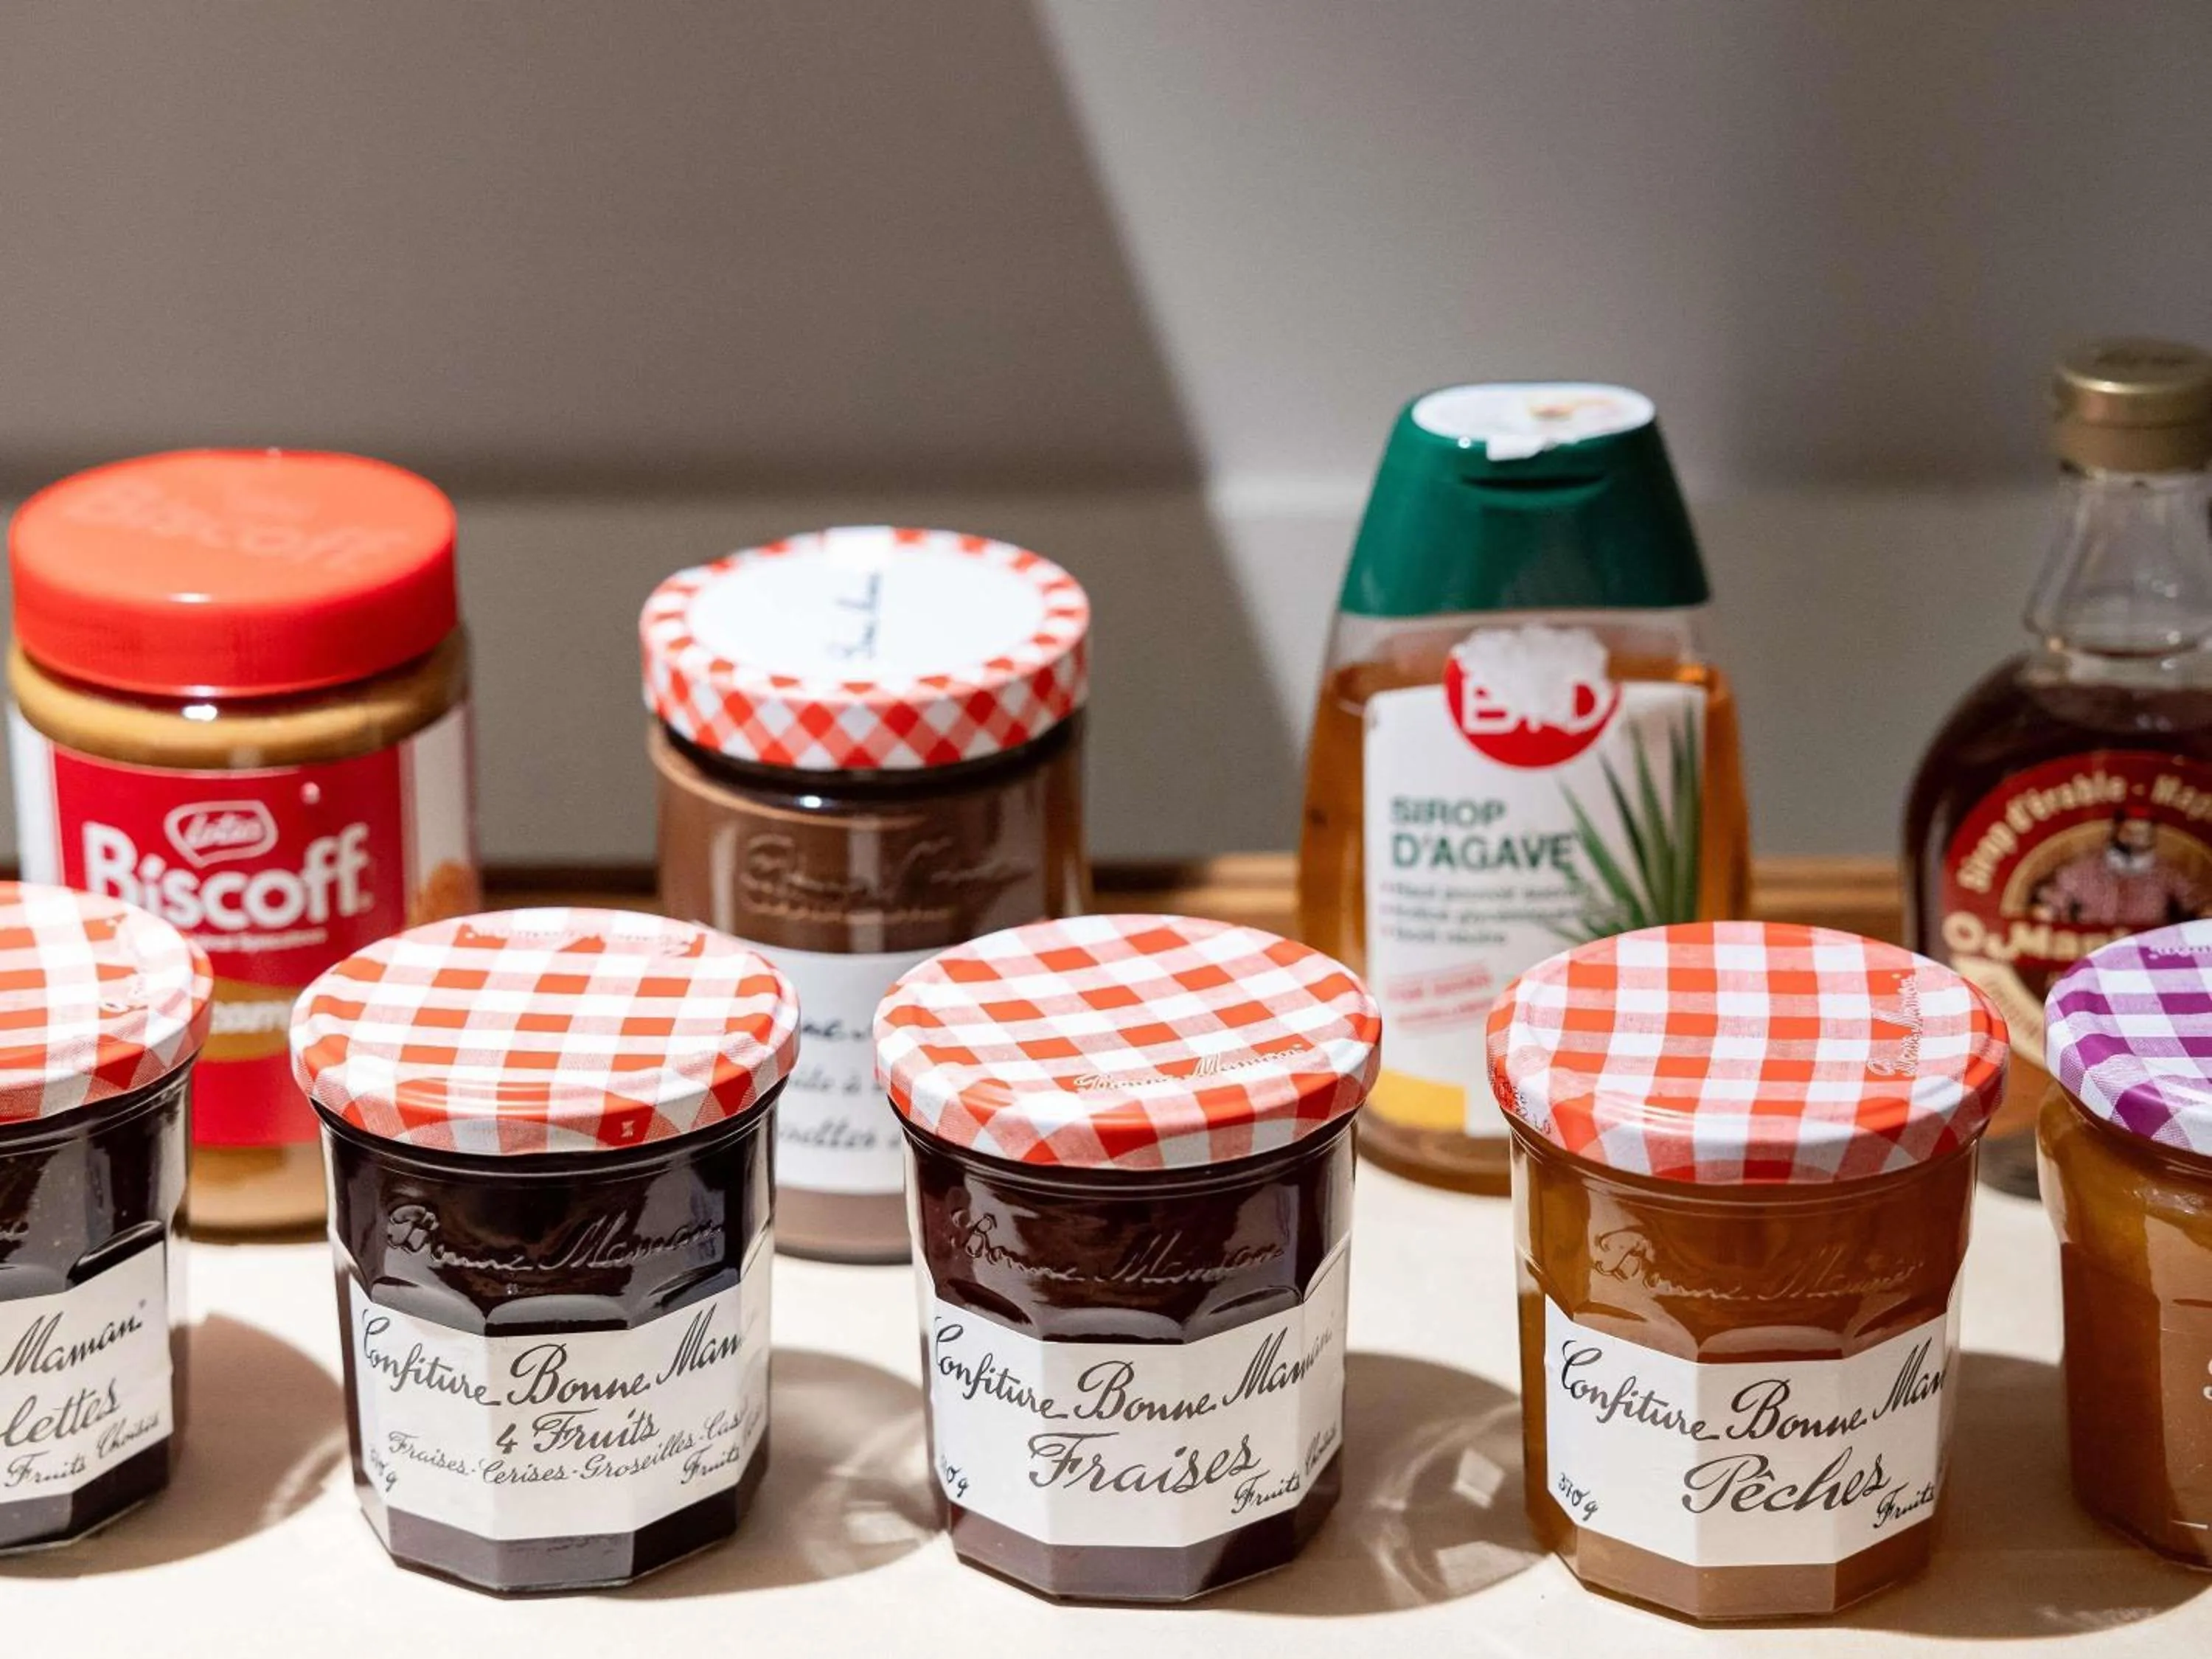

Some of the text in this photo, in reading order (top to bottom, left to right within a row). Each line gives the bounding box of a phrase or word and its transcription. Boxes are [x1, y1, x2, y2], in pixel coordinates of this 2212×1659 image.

[1391, 794, 1506, 827] SIROP
[82, 821, 371, 931] Biscoff
[1391, 831, 1576, 872] D'AGAVE
[0, 1311, 142, 1377] Maman
[362, 1308, 501, 1406] Confiture
[507, 1343, 651, 1405] Bonne
[933, 1316, 1068, 1419] Confiture
[1074, 1360, 1217, 1422] Bonne
[1561, 1339, 1720, 1441] Confiture
[1725, 1378, 1868, 1440] Bonne
[495, 1407, 661, 1455] 4 Fruits
[679, 1443, 740, 1485] Fruits
[1027, 1432, 1262, 1495] Fraises
[1230, 1469, 1301, 1514] Fruits
[1681, 1445, 1892, 1514] Pêches
[1872, 1481, 1935, 1529] Fruits
